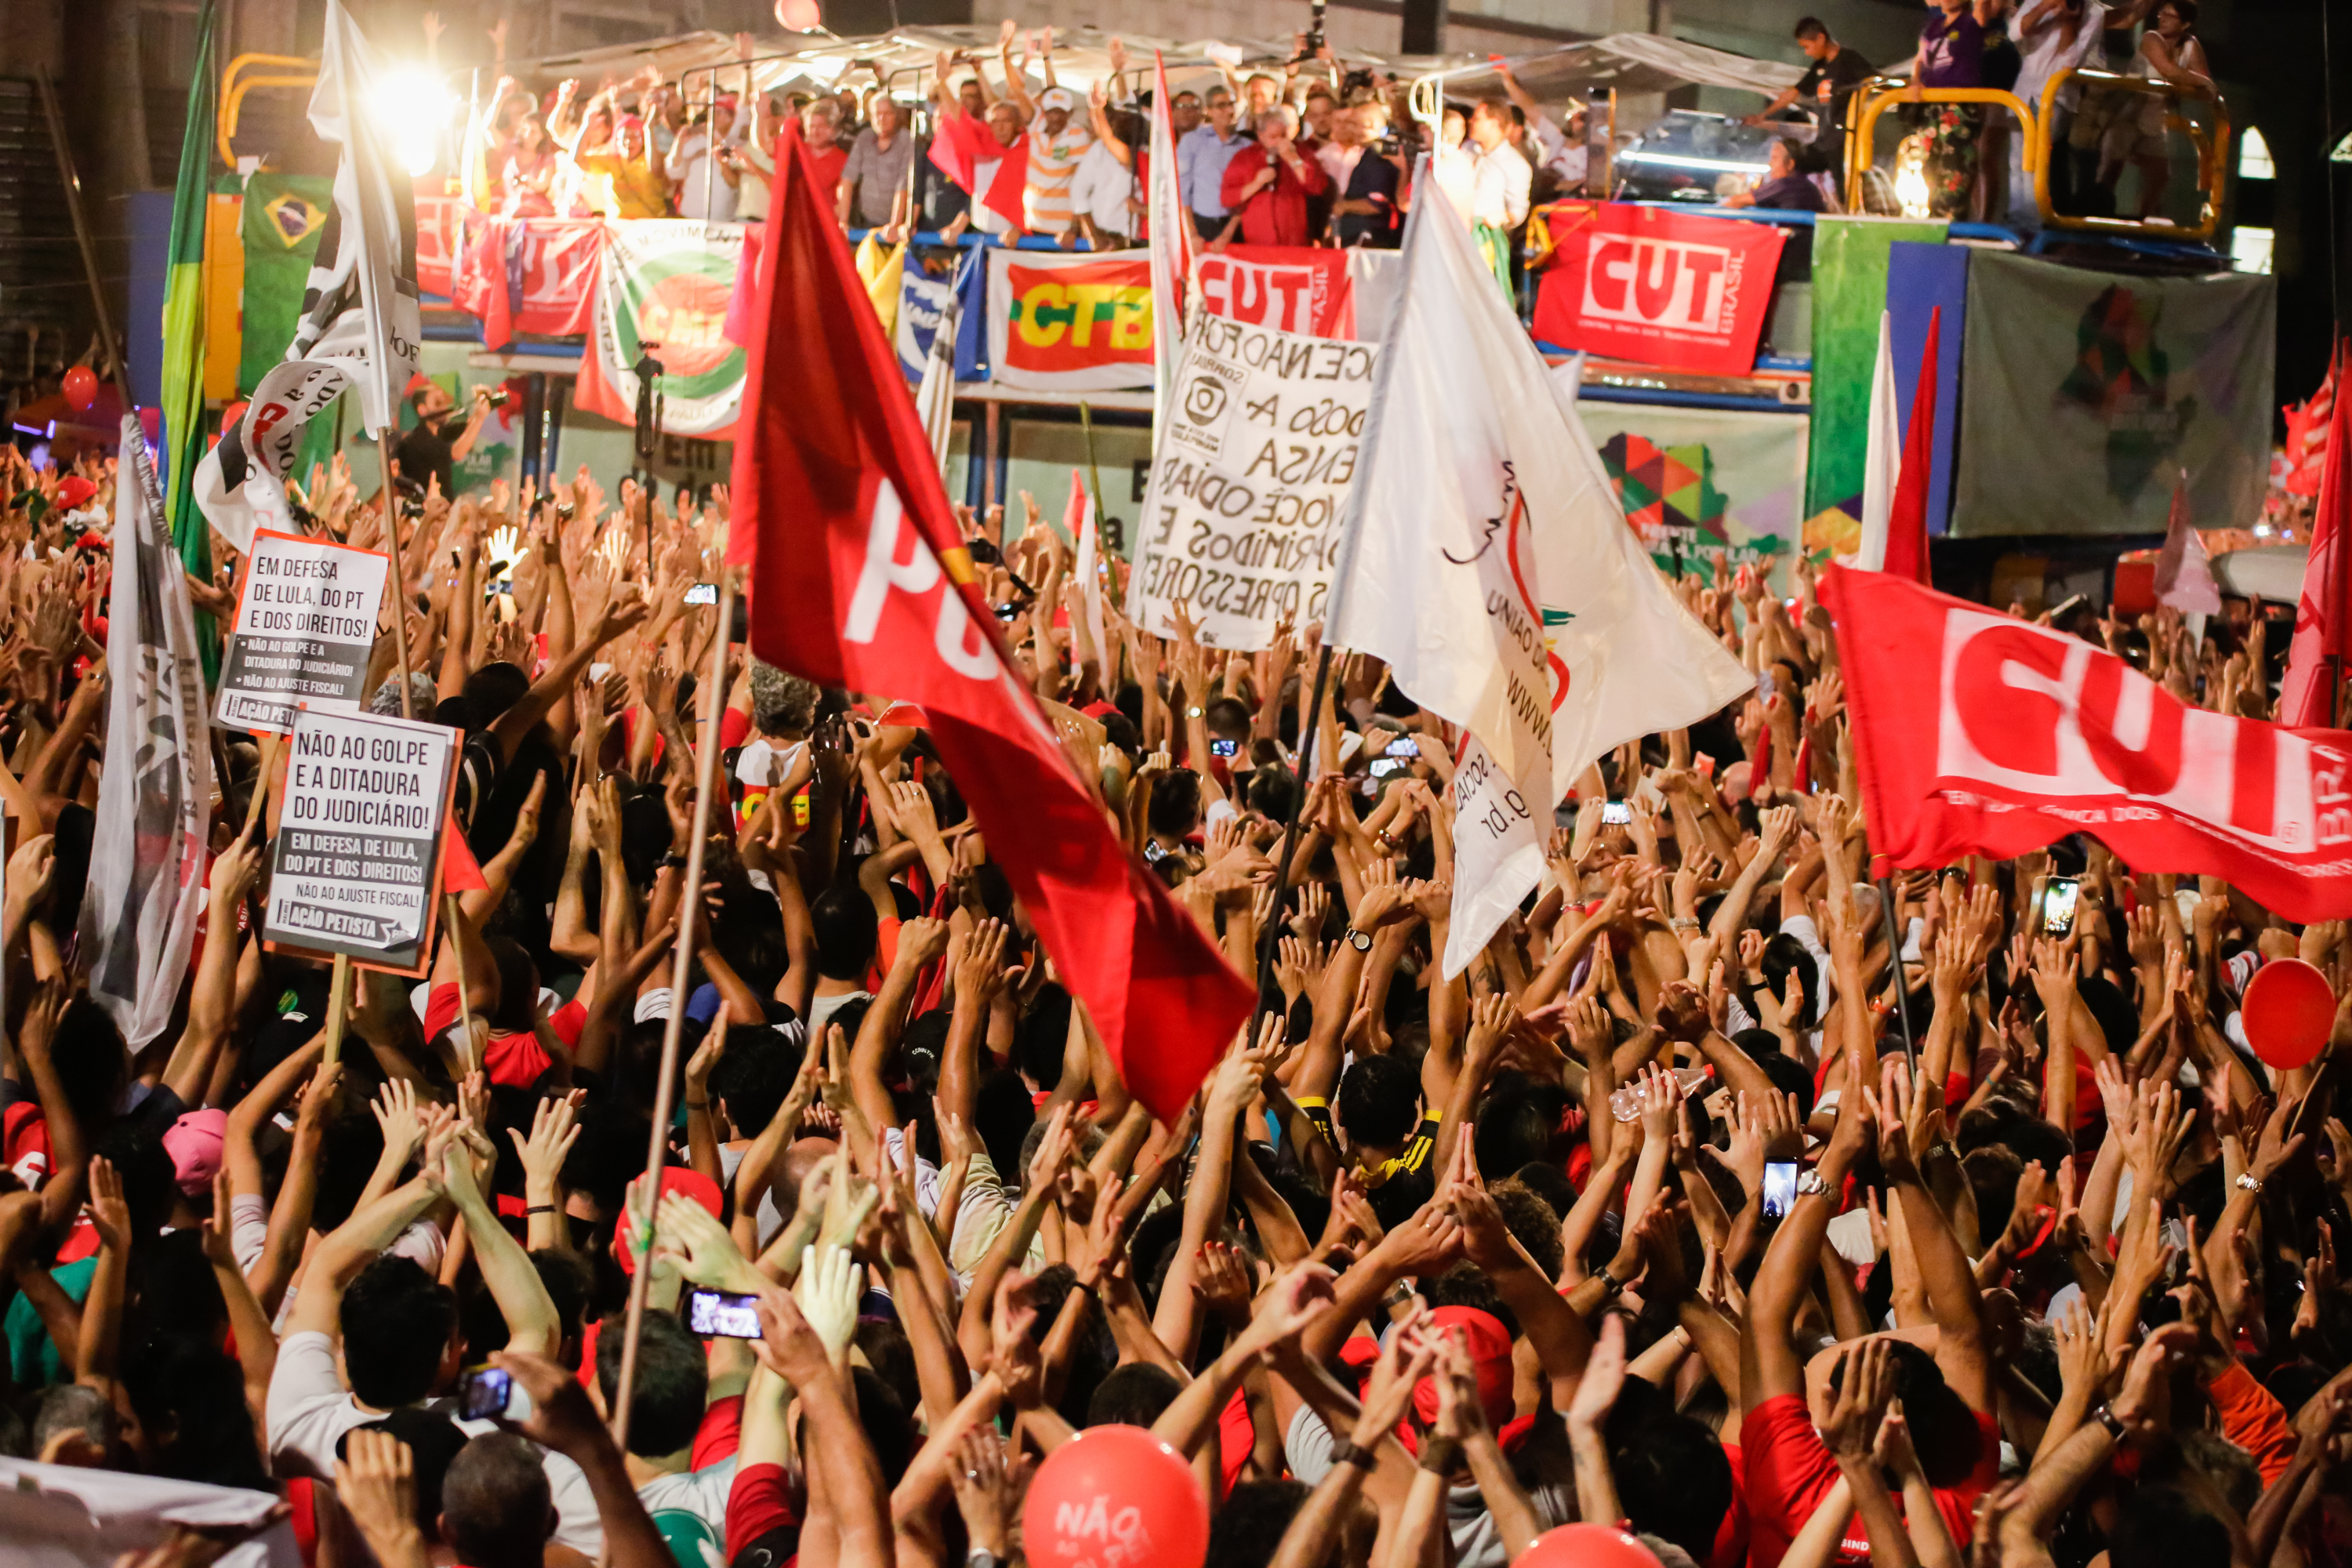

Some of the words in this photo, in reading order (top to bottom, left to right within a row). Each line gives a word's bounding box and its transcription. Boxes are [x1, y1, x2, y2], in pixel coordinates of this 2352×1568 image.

[1199, 260, 1309, 332] CUT
[1592, 241, 1723, 320] CUT
[1721, 248, 1747, 336] BRASIL
[1020, 282, 1154, 350] CTB
[257, 556, 280, 575] EM
[283, 558, 339, 580] DEFESA
[253, 583, 274, 603] DE
[277, 586, 316, 608] LULA,
[321, 588, 341, 608] DO
[345, 590, 365, 610] PT
[250, 610, 260, 629] E
[263, 611, 293, 630] DOS
[296, 613, 368, 638] DIREITOS!
[248, 637, 267, 652] NÃO
[267, 639, 281, 652] AO
[281, 641, 309, 655] GOLPE
[310, 643, 317, 655] E
[317, 644, 325, 657] A
[244, 655, 289, 670] DITADURA
[289, 658, 302, 671] DO
[303, 659, 354, 677] JUDICIÁRIO!
[243, 673, 263, 688] NÃO
[263, 676, 276, 689] AO
[277, 677, 309, 693] AJUSTE
[310, 680, 345, 696] FISCAL!
[238, 699, 270, 721] AÇÃO
[270, 706, 295, 724] PETI
[1954, 625, 2278, 837] CUT
[298, 729, 336, 757] NÃO
[341, 736, 365, 760] AO
[372, 738, 430, 766] GOLPE
[296, 764, 307, 787] E
[312, 765, 324, 789] A
[330, 767, 420, 797] DITADURA
[294, 796, 318, 820] DO
[322, 798, 430, 829] JUDICIÁRIO!
[291, 832, 311, 851] EM
[314, 834, 362, 855] DEFESA
[364, 838, 381, 856] DE
[383, 840, 419, 862] LULA,
[285, 855, 303, 872] DO
[304, 855, 322, 873] PT
[322, 857, 332, 875] E
[333, 858, 360, 877] DOS
[361, 861, 423, 884] DIREITOS!
[296, 882, 318, 898] NÃO
[321, 886, 336, 900] AO
[338, 887, 376, 905] AJUSTE
[379, 891, 419, 908] FISCAL!
[290, 906, 325, 927] AÇÃO
[325, 911, 376, 938] PETISTA
[1054, 1494, 1142, 1543] NÃO
